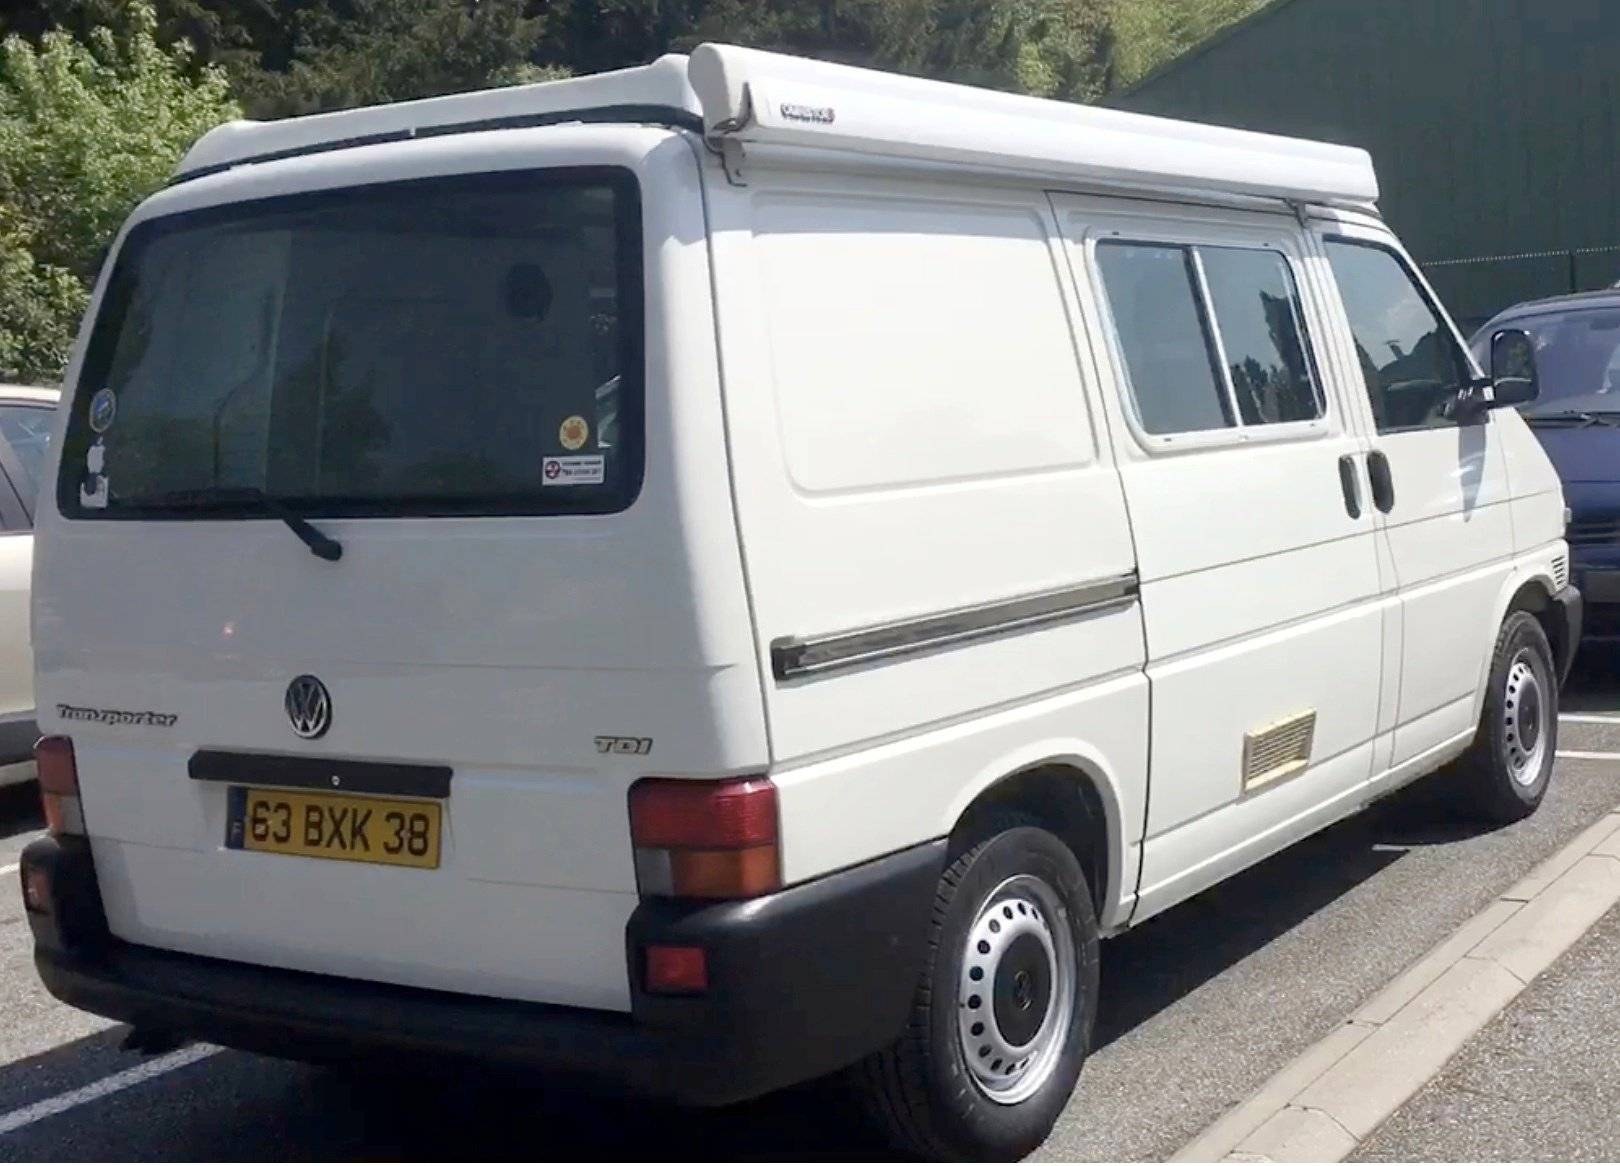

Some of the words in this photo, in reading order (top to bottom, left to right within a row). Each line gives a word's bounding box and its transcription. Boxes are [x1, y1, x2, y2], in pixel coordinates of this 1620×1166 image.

[57, 703, 178, 726] Transporter
[593, 735, 654, 755] TDI
[252, 800, 292, 843] 63
[304, 804, 372, 851] BXK
[383, 811, 430, 856] 38
